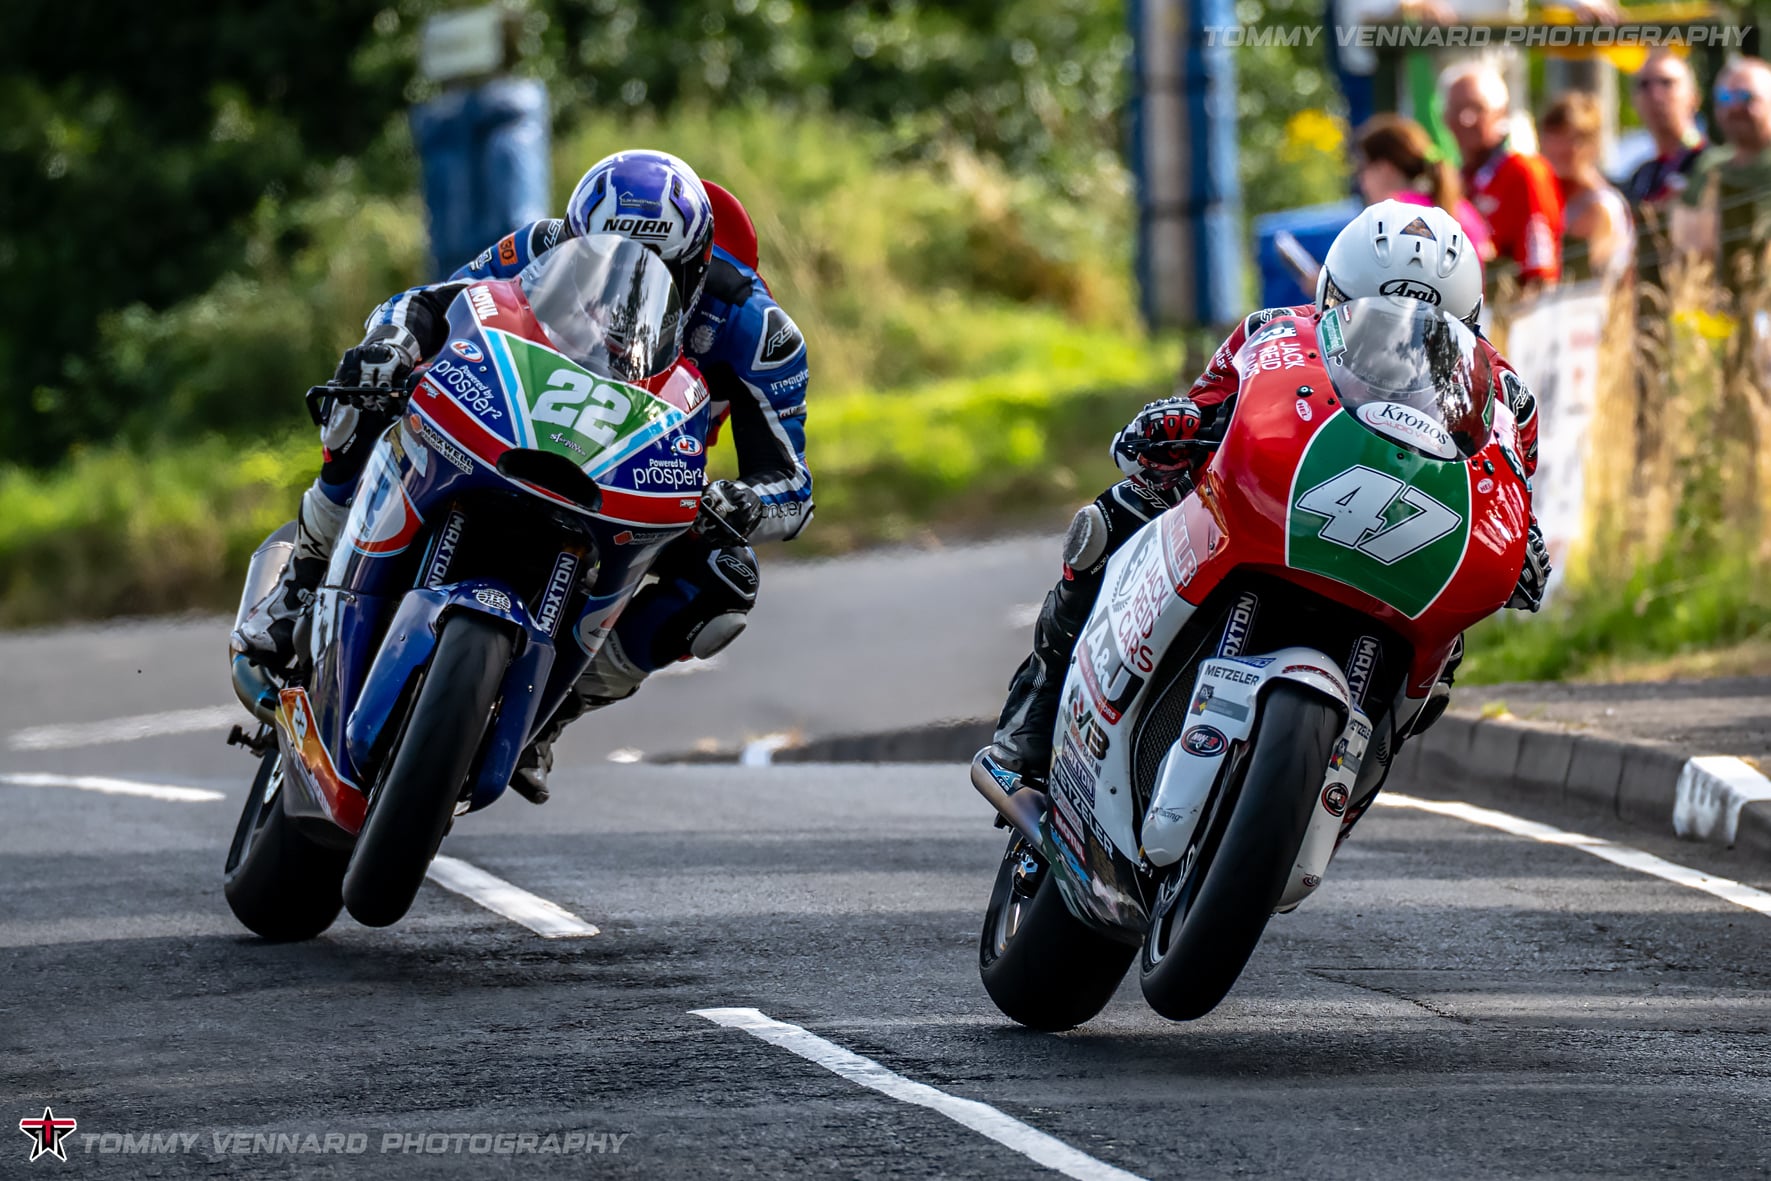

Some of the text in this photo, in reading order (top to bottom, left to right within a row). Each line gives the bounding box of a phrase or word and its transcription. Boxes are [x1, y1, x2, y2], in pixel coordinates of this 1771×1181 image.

[602, 219, 673, 240] NOLAN
[469, 285, 499, 320] MOTUL
[1383, 281, 1437, 304] Arai
[1259, 345, 1282, 370] REID
[1280, 342, 1305, 370] JACK
[460, 365, 494, 400] Powered by
[531, 369, 632, 449] 22
[1379, 404, 1449, 444] Kronos
[423, 424, 474, 469] MAXWELL
[444, 451, 473, 474] SERVICES
[650, 458, 687, 470] Powered by
[1297, 465, 1462, 565] 47
[429, 513, 465, 587] MAXTON
[718, 554, 759, 586] RST
[538, 556, 575, 632] MAXTON
[1146, 556, 1169, 617] JACK
[1132, 582, 1154, 639] REID
[1223, 595, 1255, 657] AXTON
[1084, 617, 1132, 702] A&J
[1118, 610, 1154, 672] CARS
[1205, 664, 1260, 686] METZELER
[1063, 736, 1094, 797] MAXTON
[1053, 760, 1113, 861] METZELER
